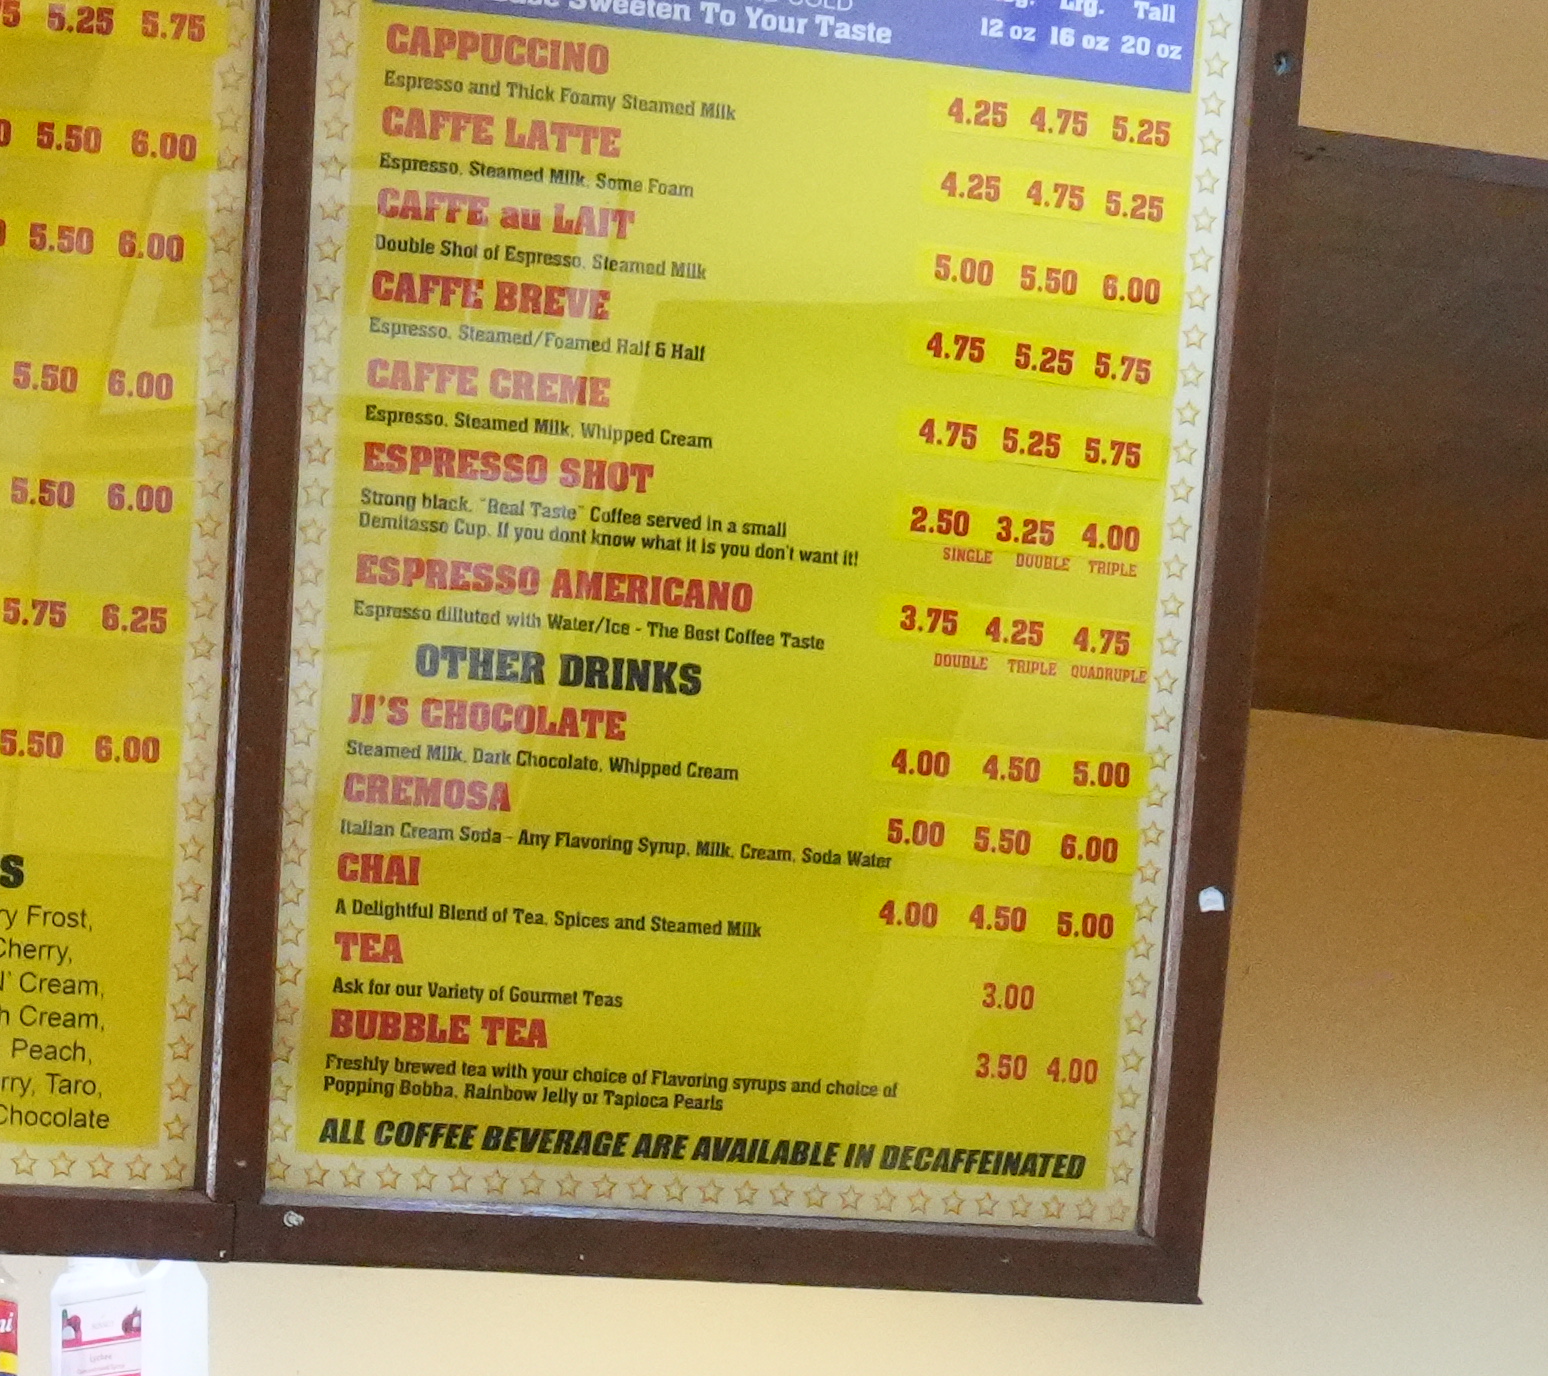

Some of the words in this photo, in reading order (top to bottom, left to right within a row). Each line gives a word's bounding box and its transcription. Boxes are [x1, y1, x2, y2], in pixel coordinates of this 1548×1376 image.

[387, 24, 608, 73] CAPPUCCINO
[382, 106, 494, 145] CAFFE
[505, 117, 621, 157] LATTE
[948, 98, 1007, 127] 4.25
[1030, 107, 1088, 137] 4.75
[1113, 116, 1171, 147] 5.25
[30, 223, 93, 254] 5.50
[119, 230, 184, 262] 6.00
[943, 547, 992, 564] SINGLE
[1016, 553, 1070, 571] DOUBLE
[1089, 560, 1137, 577] TRIPLE
[416, 644, 545, 685] OTHER
[559, 654, 701, 695] DRINKS
[344, 773, 511, 812] CREMOSA
[338, 853, 420, 886] CHAI
[330, 1009, 470, 1044] BUBBLE
[481, 1016, 547, 1048] TEA
[319, 1118, 365, 1144] ALL
[375, 1121, 478, 1149] COFFEE
[481, 1126, 629, 1157] BEVERAGE
[632, 1133, 689, 1160] ARE
[691, 1136, 840, 1167] AVAILABLE
[844, 1144, 875, 1168] IN
[880, 1145, 1086, 1179] DECAFFEINATED
